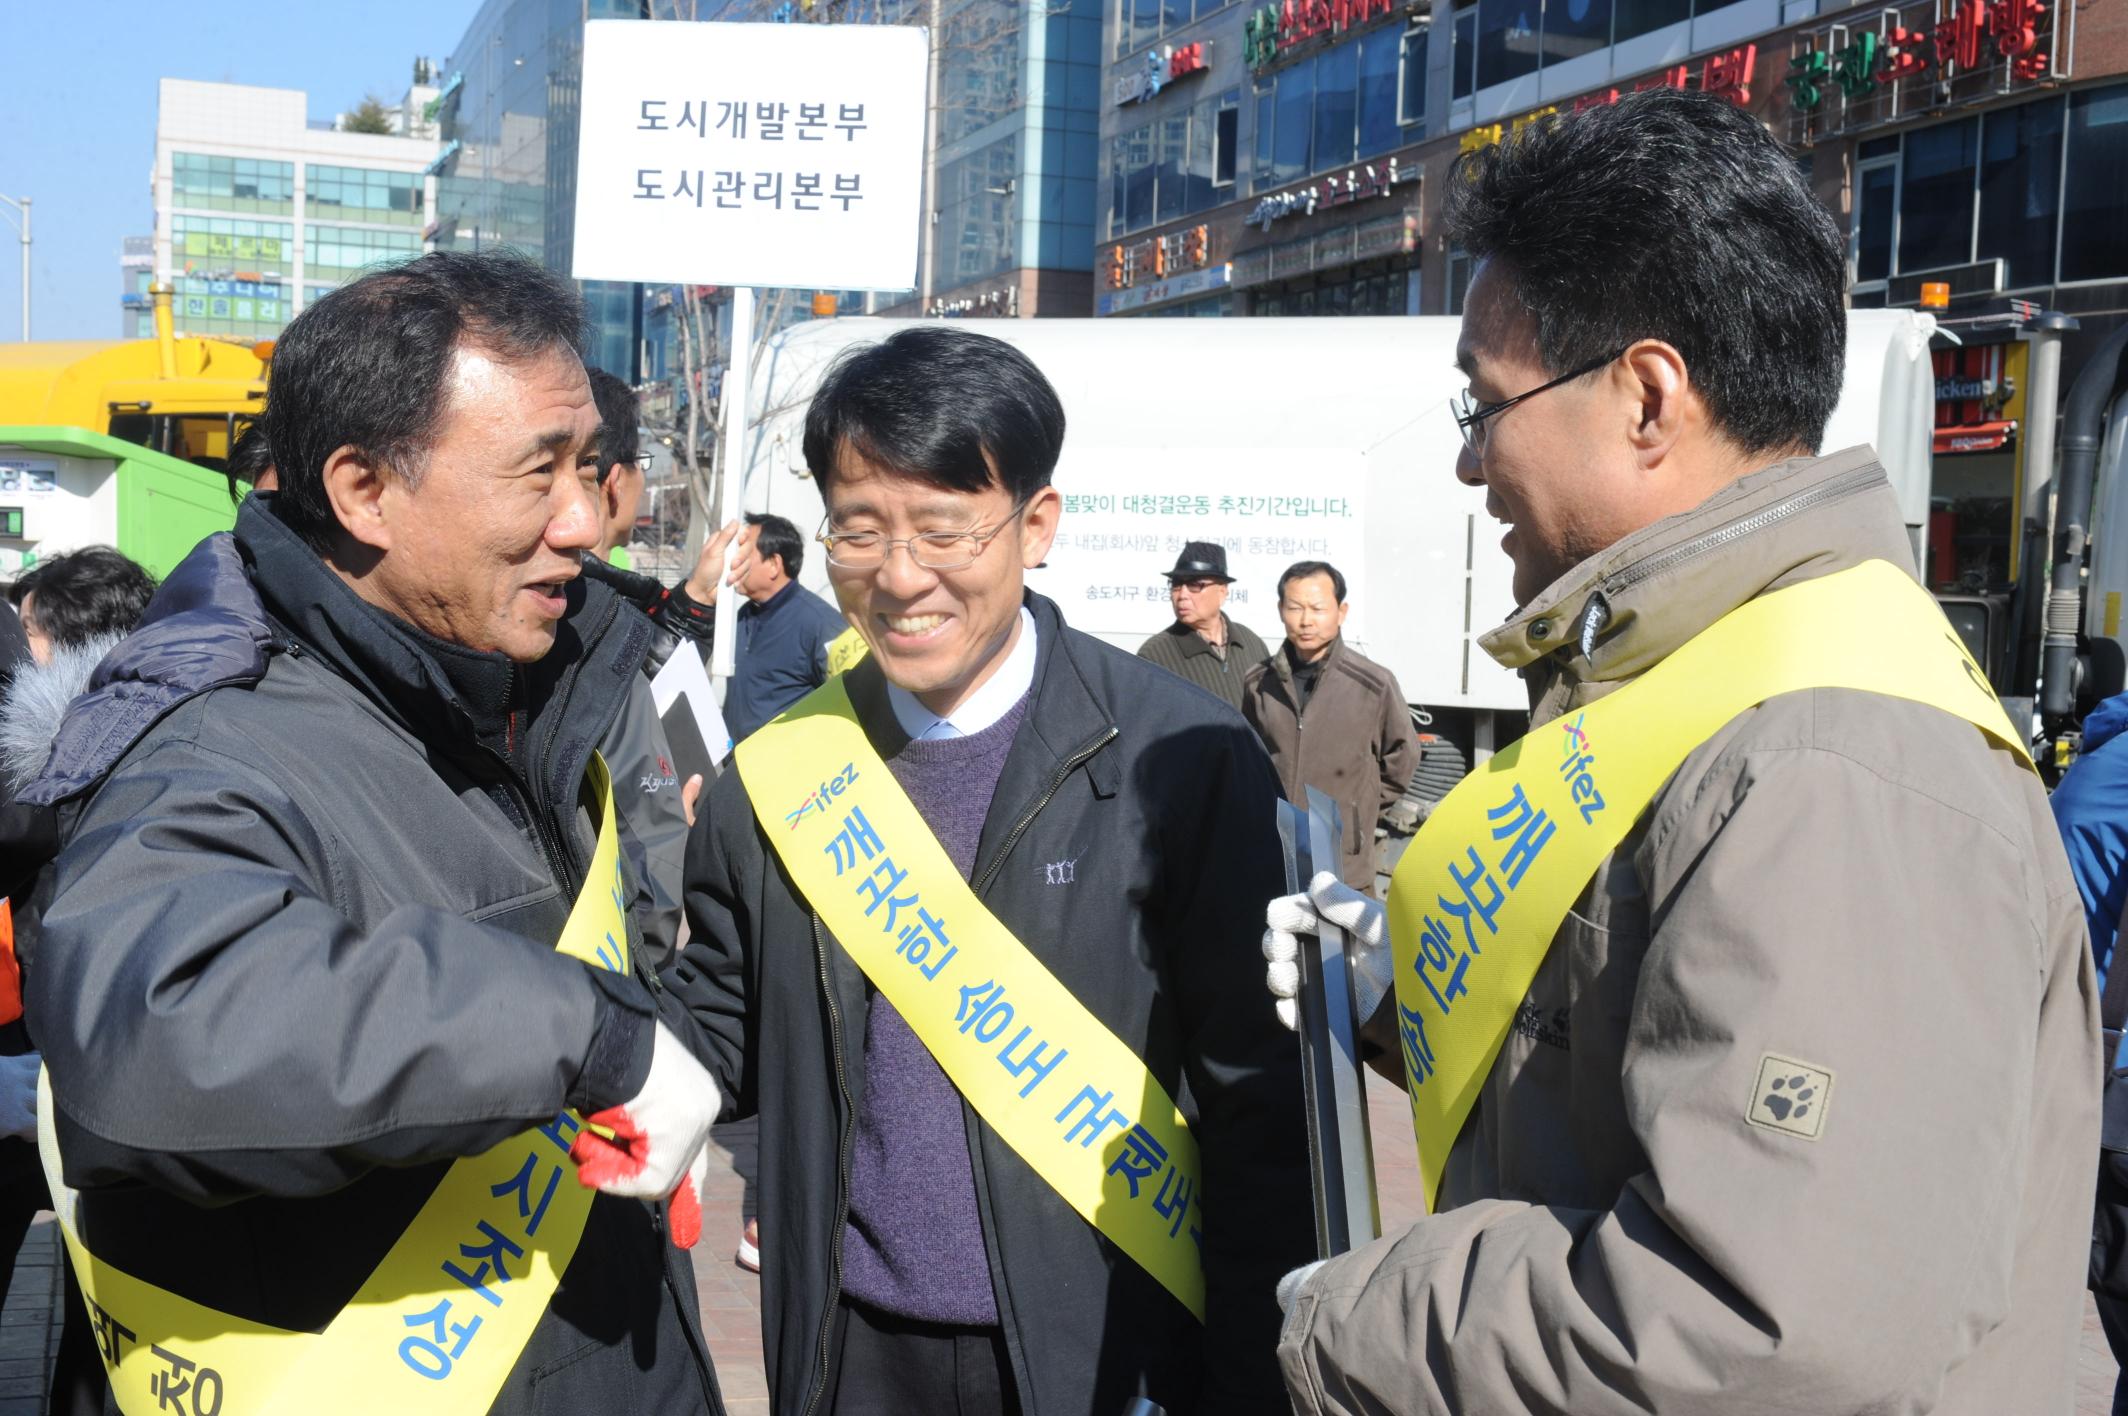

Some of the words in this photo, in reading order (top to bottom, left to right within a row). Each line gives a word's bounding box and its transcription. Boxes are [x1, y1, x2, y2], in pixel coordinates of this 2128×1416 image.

[636, 100, 867, 142] 도시개발본부
[633, 169, 863, 211] 도시관리본부
[1935, 380, 1981, 400] icken
[1059, 494, 1115, 514] 봄맞이
[1123, 495, 1211, 516] 대청결운동
[1218, 495, 1352, 518] 추진기간입니다.
[1052, 533, 1070, 550] 두
[1075, 533, 1159, 553] 내집(회사)앞
[1248, 537, 1331, 557] 동참합시다.
[1086, 585, 1140, 601] 송도지구
[813, 761, 861, 815] ifez
[1560, 742, 1606, 825] ifez
[1414, 783, 1557, 1015] 깨끗한
[823, 805, 958, 982] 깨끗한
[954, 977, 1068, 1099] 송도
[1054, 1082, 1202, 1246] 국제도
[397, 1219, 526, 1382] 조성
